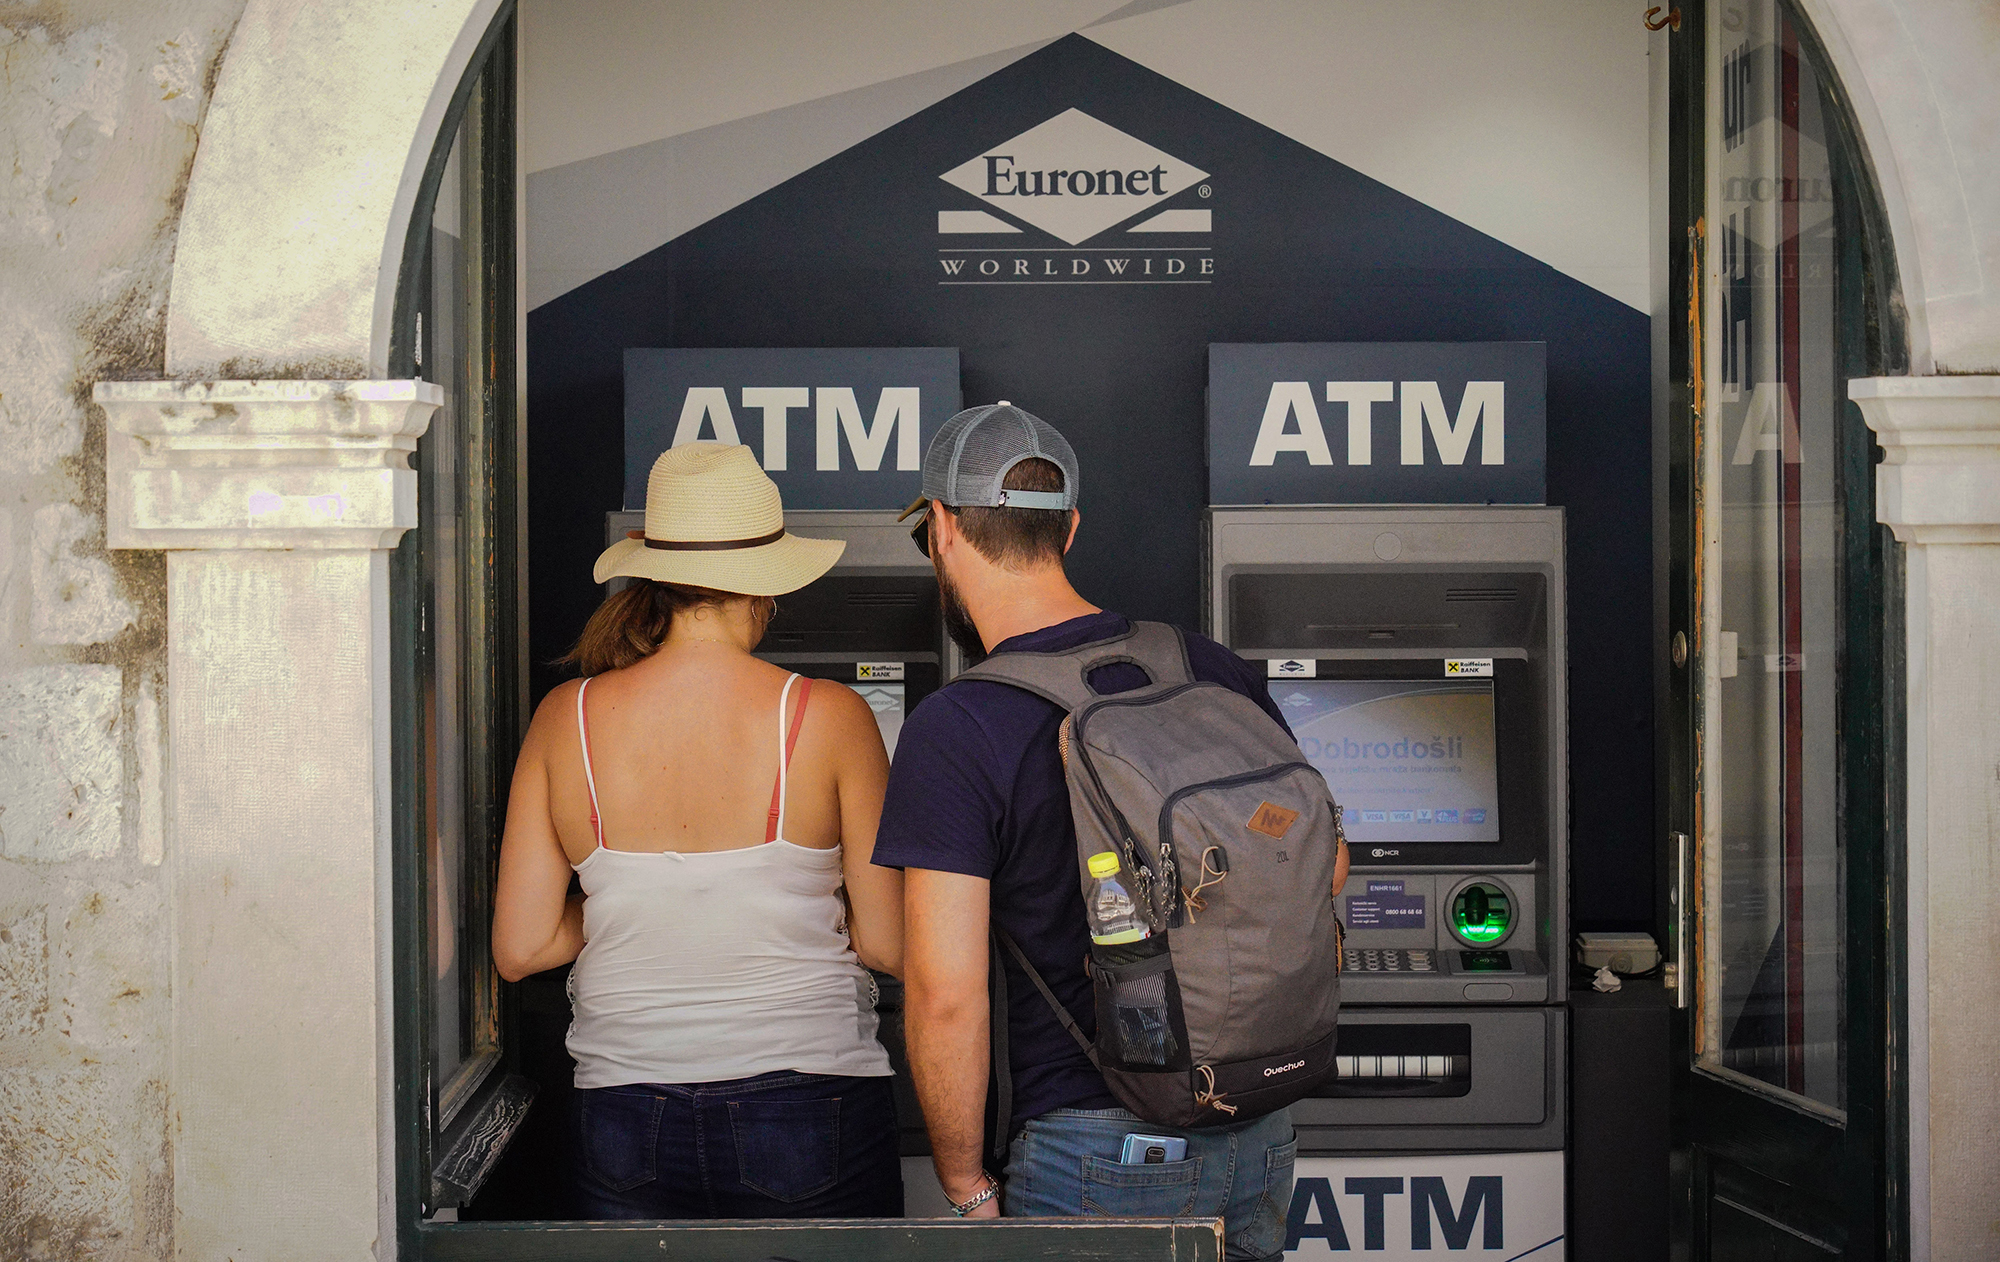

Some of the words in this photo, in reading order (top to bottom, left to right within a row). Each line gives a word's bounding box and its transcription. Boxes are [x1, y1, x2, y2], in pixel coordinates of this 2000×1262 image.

[981, 155, 1168, 197] Euronet
[940, 258, 1214, 275] WORLDWIDE
[671, 387, 920, 471] ATM
[1249, 381, 1505, 466] ATM
[1301, 736, 1463, 759] Dobrodošli
[1366, 813, 1384, 821] VISA
[1394, 812, 1411, 820] VISA
[1263, 1059, 1306, 1077] Quechua
[1283, 1175, 1504, 1251] ATM
